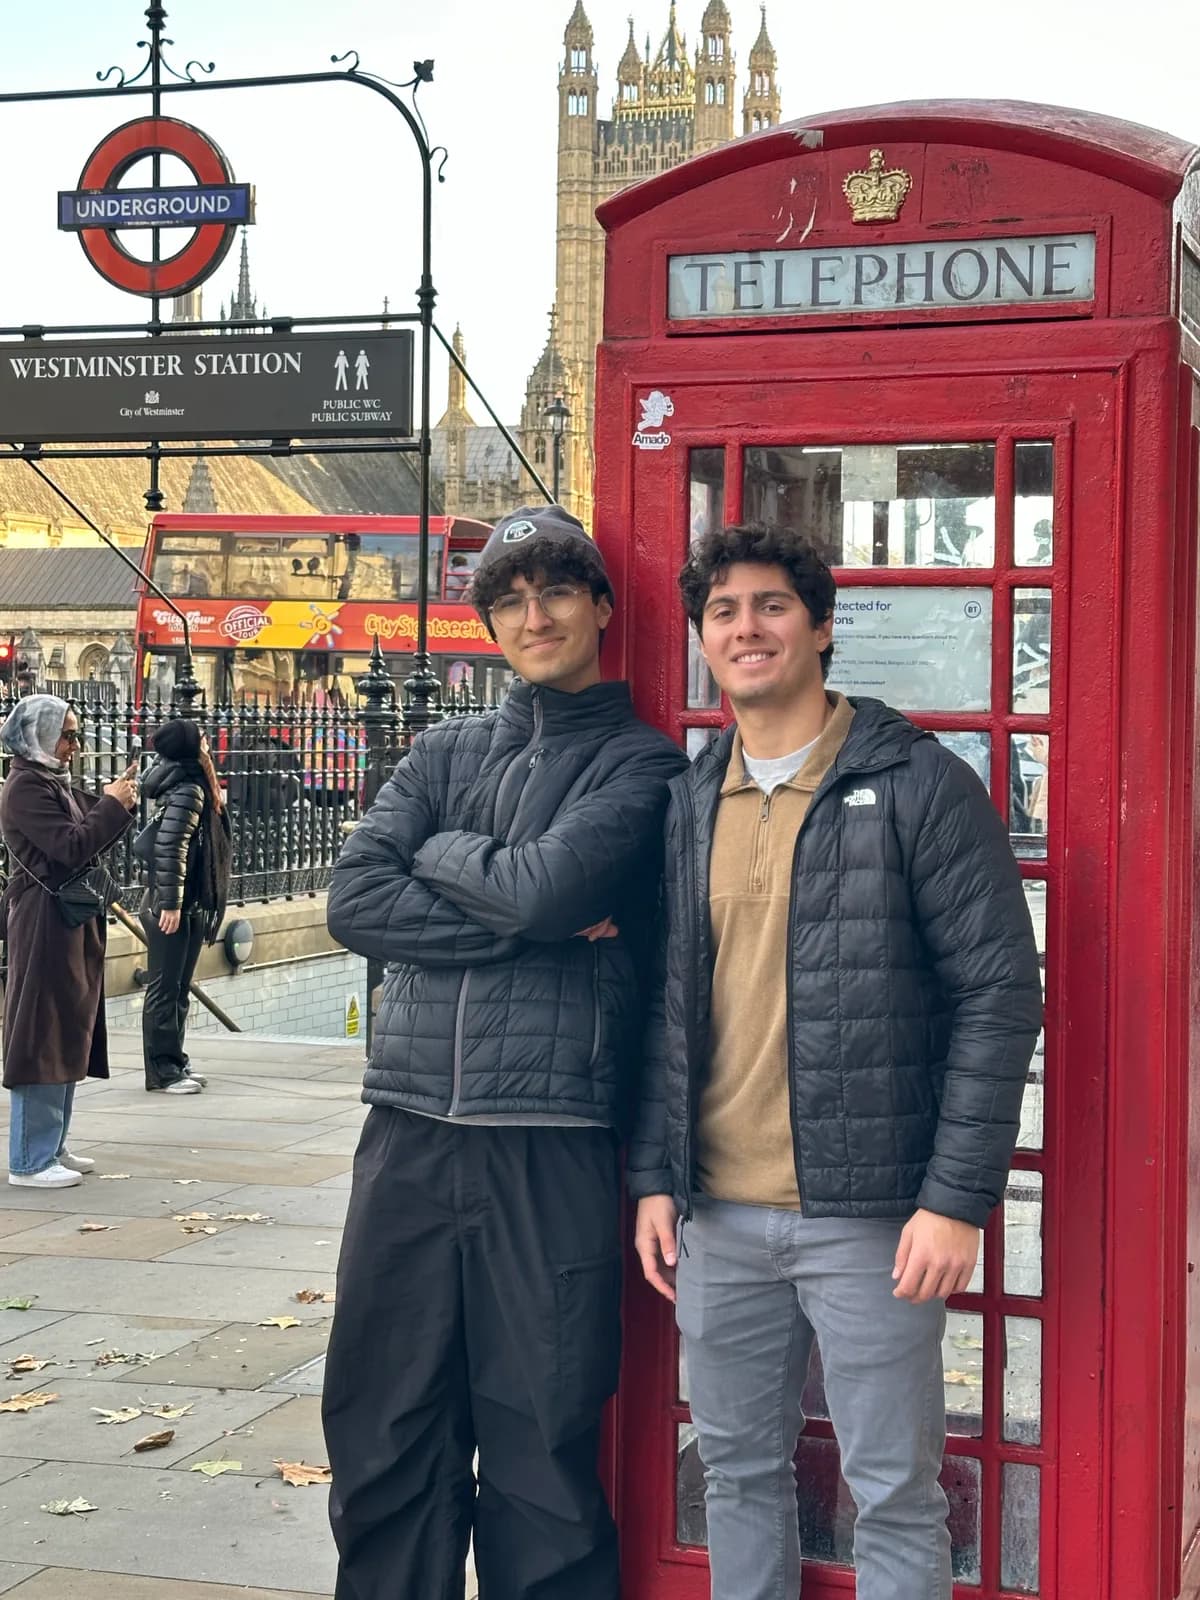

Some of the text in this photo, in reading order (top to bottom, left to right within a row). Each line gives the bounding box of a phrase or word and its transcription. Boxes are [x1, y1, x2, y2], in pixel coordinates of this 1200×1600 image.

[76, 195, 231, 218] UNDERGROUND
[684, 242, 1078, 313] TELEPHONE
[9, 352, 302, 379] WESTMINSTER STATION
[323, 399, 381, 409] PUBLIC WC
[119, 407, 185, 419] City of Westminster
[311, 411, 393, 422] PUBLIC SUBWAY
[633, 433, 670, 445] Amado
[875, 601, 892, 611] for
[168, 624, 199, 632] LONON
[224, 616, 269, 633] OFFICIAL
[365, 614, 496, 643] CitySitseein
[238, 628, 259, 639] TOUR
